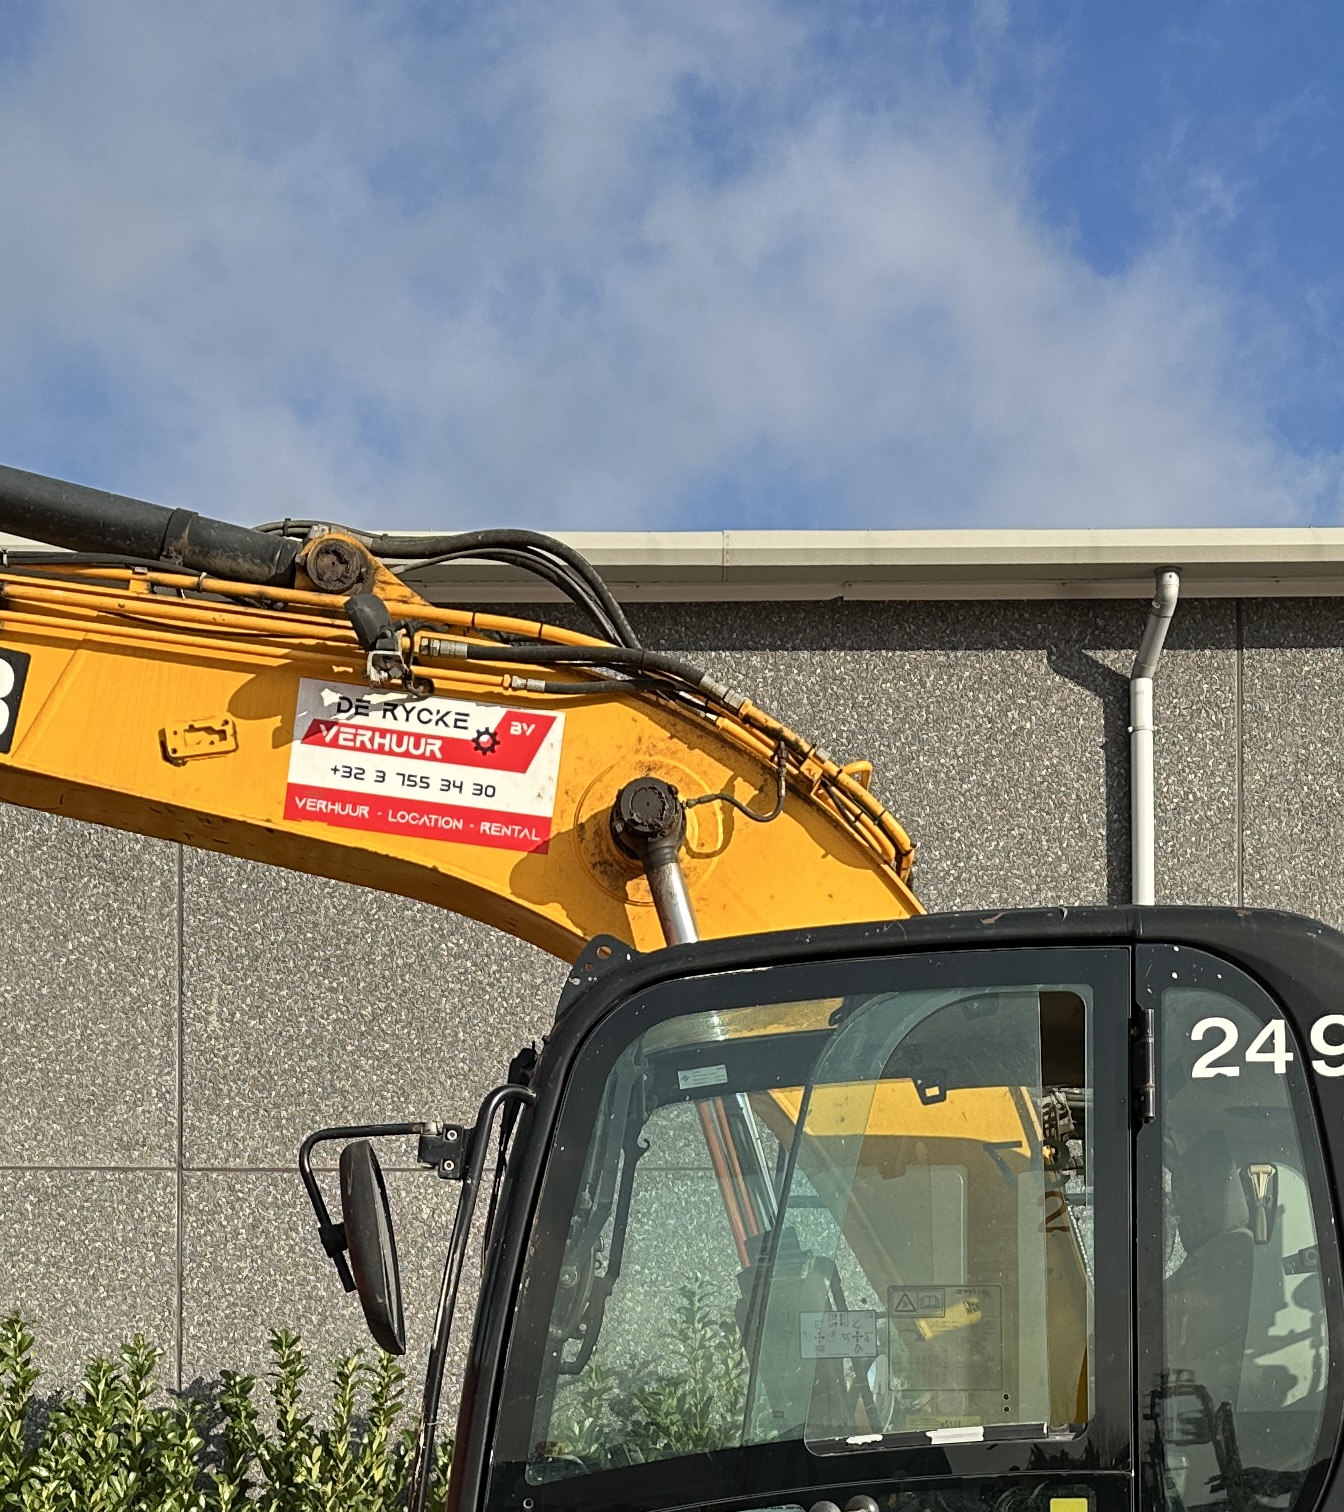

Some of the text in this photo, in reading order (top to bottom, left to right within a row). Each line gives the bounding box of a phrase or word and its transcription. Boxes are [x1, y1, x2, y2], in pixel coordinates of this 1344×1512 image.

[336, 696, 471, 730] DE RYCKE
[319, 723, 443, 759] VERHUUR
[330, 764, 496, 798] +32 3 755 34 30
[294, 795, 370, 819] VERHUUR
[388, 808, 463, 830] LOCATION
[479, 821, 541, 841] RENTAL
